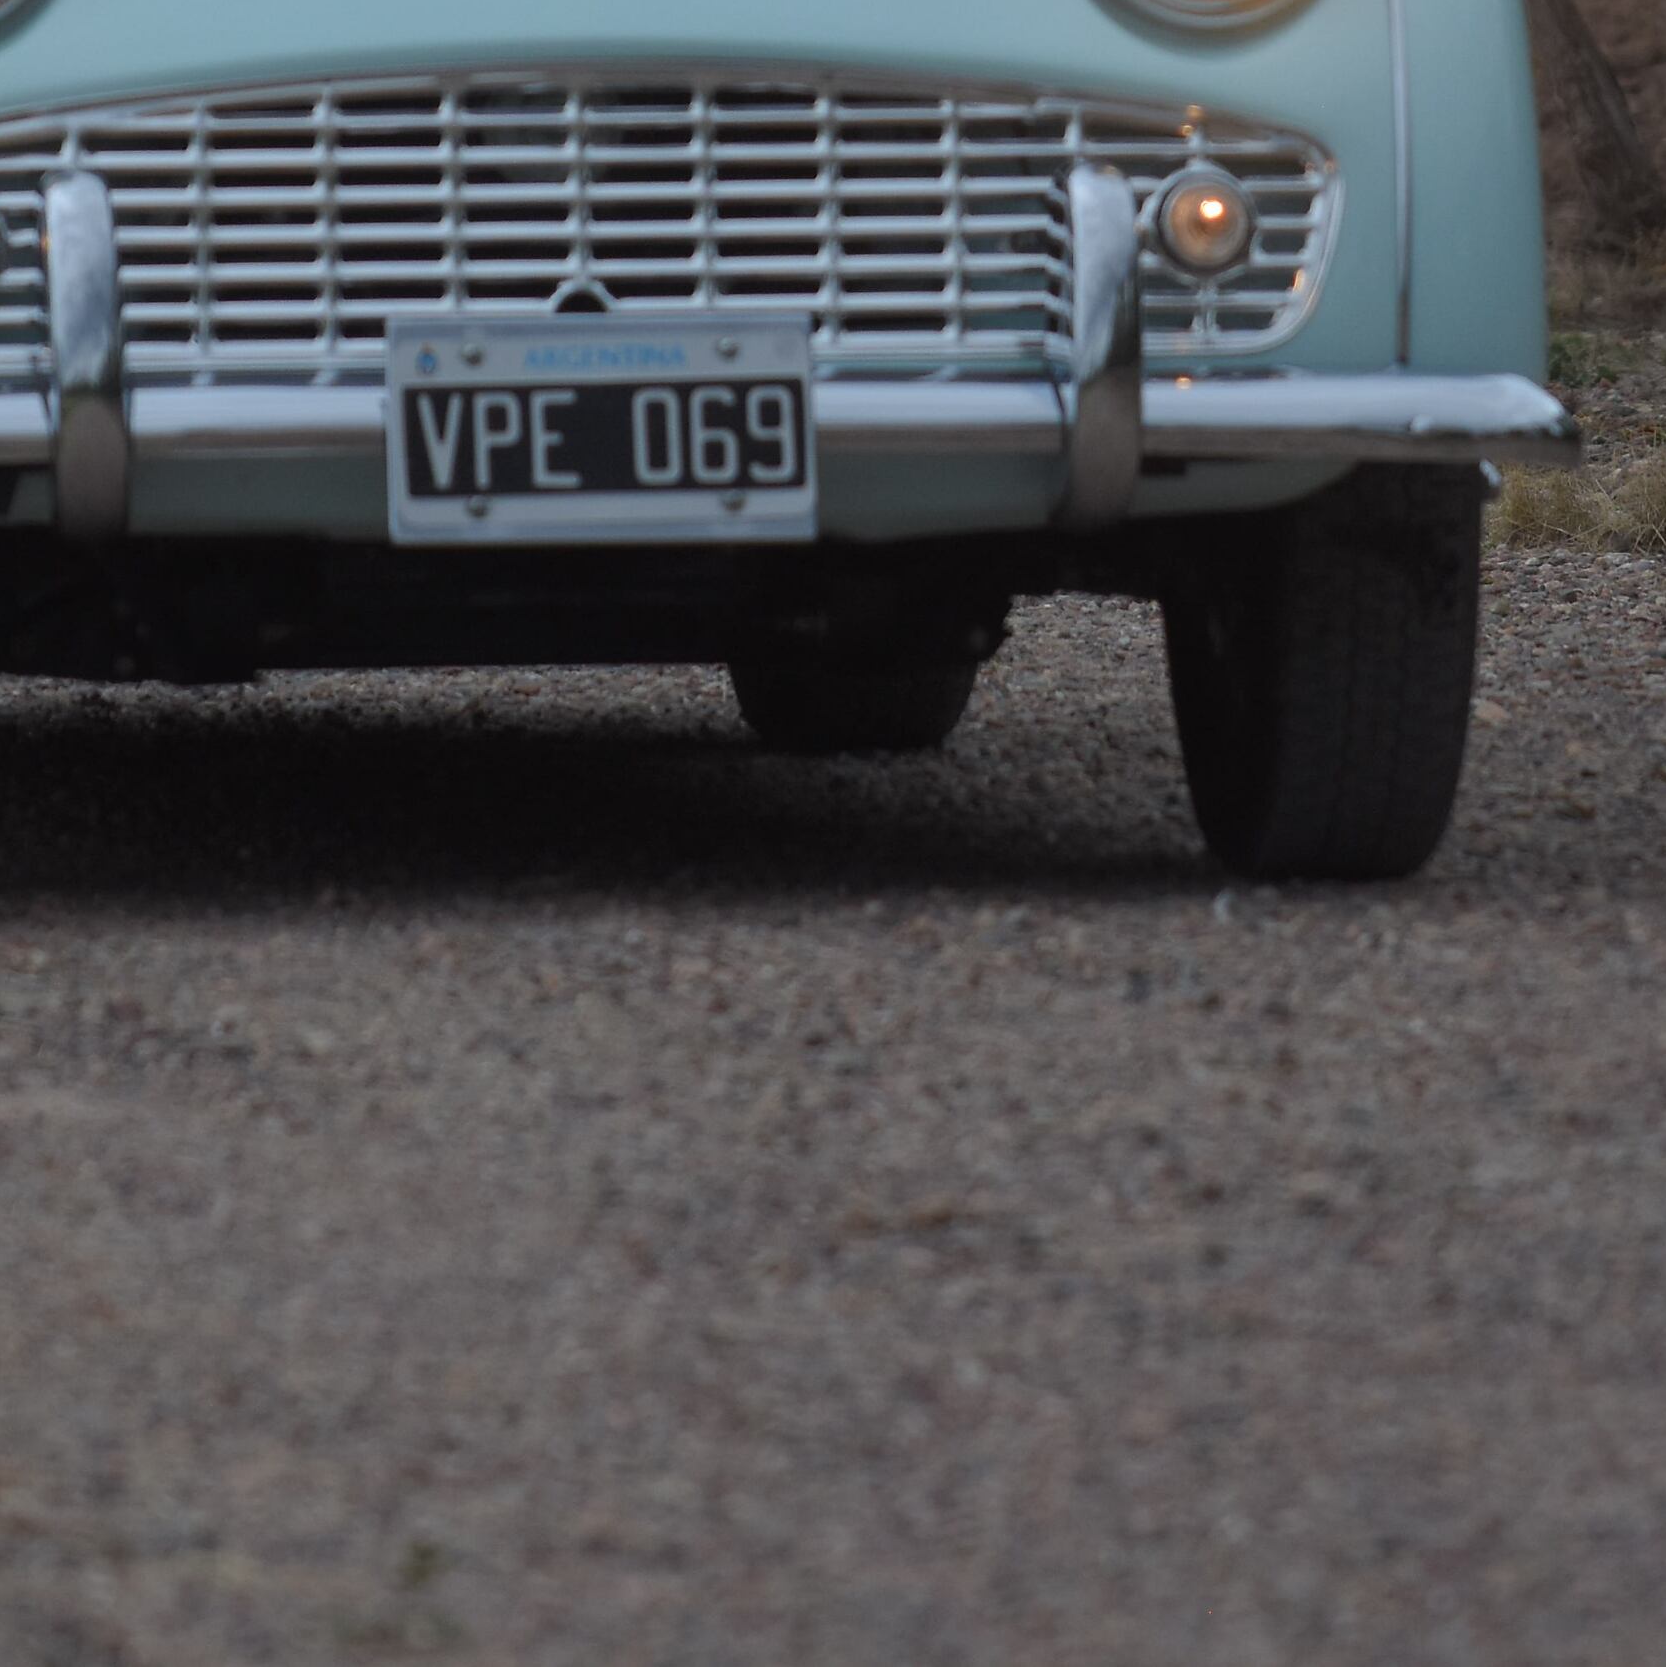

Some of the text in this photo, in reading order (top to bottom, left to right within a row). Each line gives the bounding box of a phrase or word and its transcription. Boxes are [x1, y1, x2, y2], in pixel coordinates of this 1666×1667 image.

[524, 343, 687, 370] ARGENTINA
[416, 383, 797, 491] VPE 069
